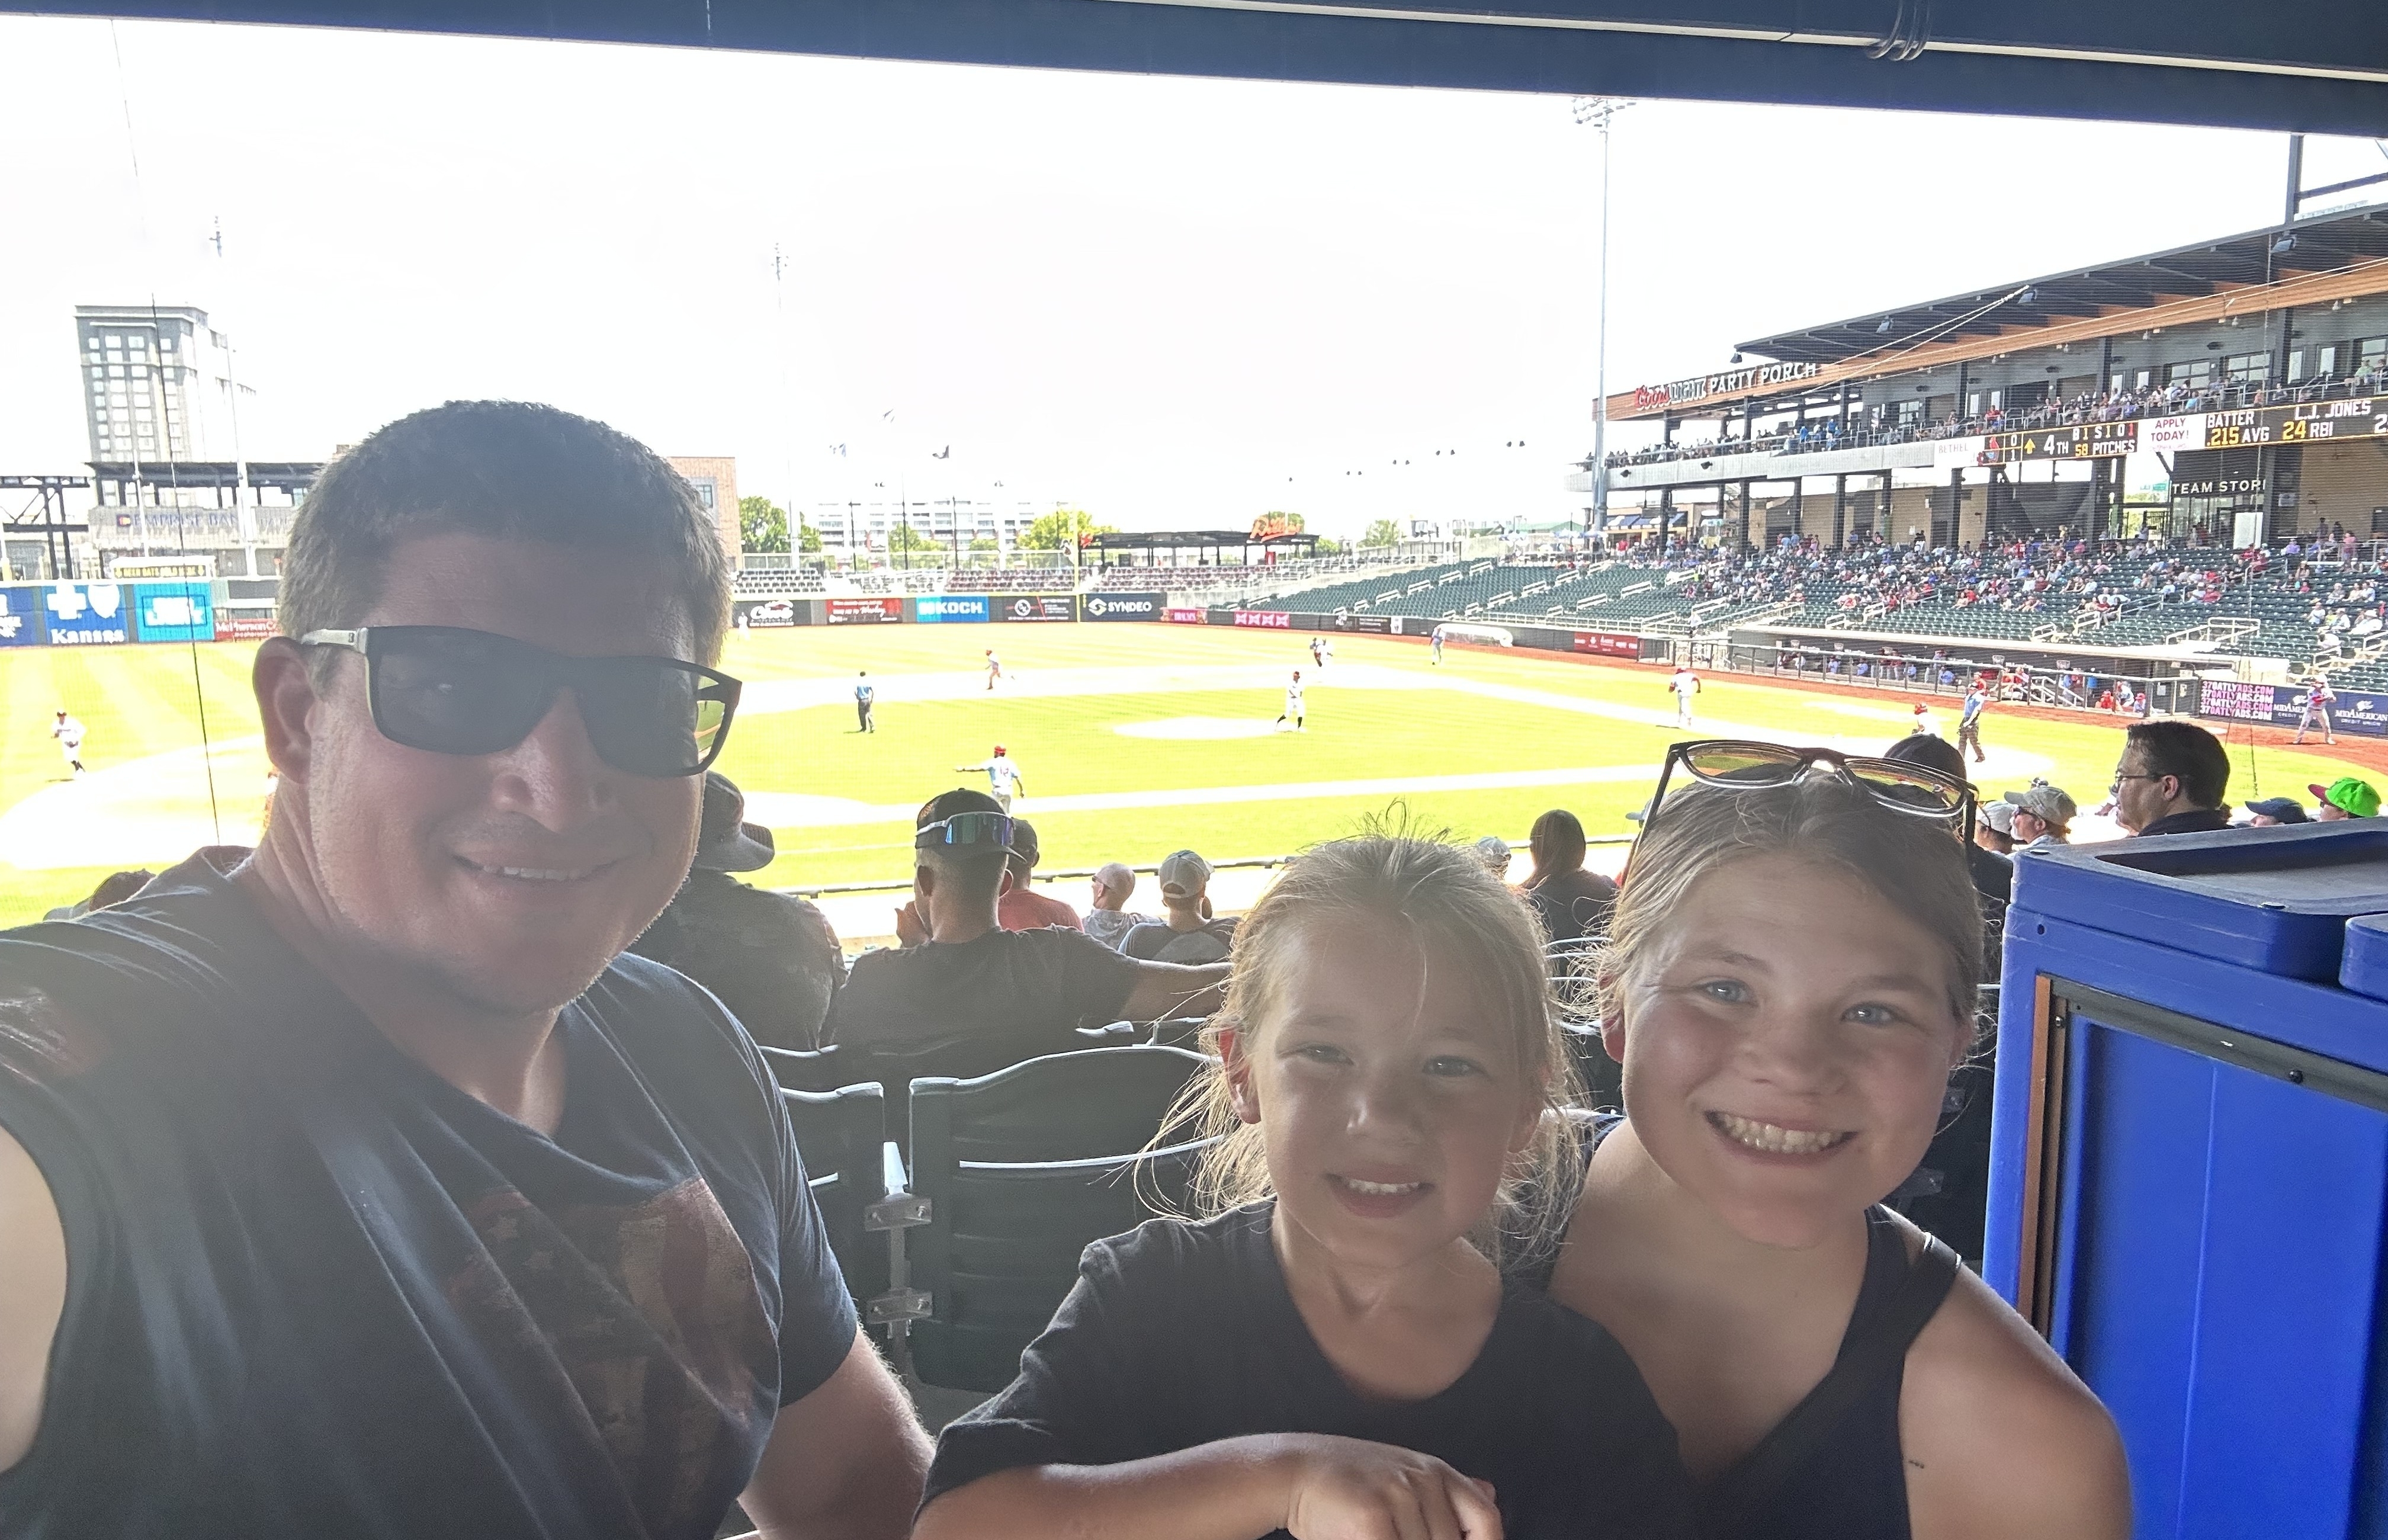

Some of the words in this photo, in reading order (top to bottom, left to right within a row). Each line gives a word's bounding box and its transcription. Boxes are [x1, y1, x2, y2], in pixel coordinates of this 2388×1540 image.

[1635, 385, 1670, 410] Coors
[1669, 378, 1706, 404] LIGHT
[1710, 368, 1756, 393] PARTY
[1761, 362, 1816, 385] PORCH
[2206, 411, 2254, 428] BATTER
[2294, 406, 2320, 421] L.J.
[2325, 401, 2371, 418] JONES
[2155, 418, 2186, 429] APPLY
[2206, 428, 2239, 447] .215
[2242, 426, 2270, 444] AVG
[2282, 421, 2306, 441] 24
[2310, 422, 2333, 438] RBI
[2374, 413, 2388, 433] 2
[2073, 425, 2079, 441] B
[2083, 425, 2088, 440] 1
[2095, 424, 2101, 439] S
[2105, 424, 2111, 439] 1
[2127, 422, 2133, 437] 1
[2151, 429, 2188, 442] TODAY!
[1938, 444, 1968, 454] BETHEL
[2092, 439, 2135, 455] PITCHES
[2010, 449, 2016, 461] 1
[2172, 482, 2213, 495] TEAM
[939, 602, 983, 614] KOCH
[1108, 601, 1152, 612] SYNDEO
[51, 628, 124, 644] Kansas
